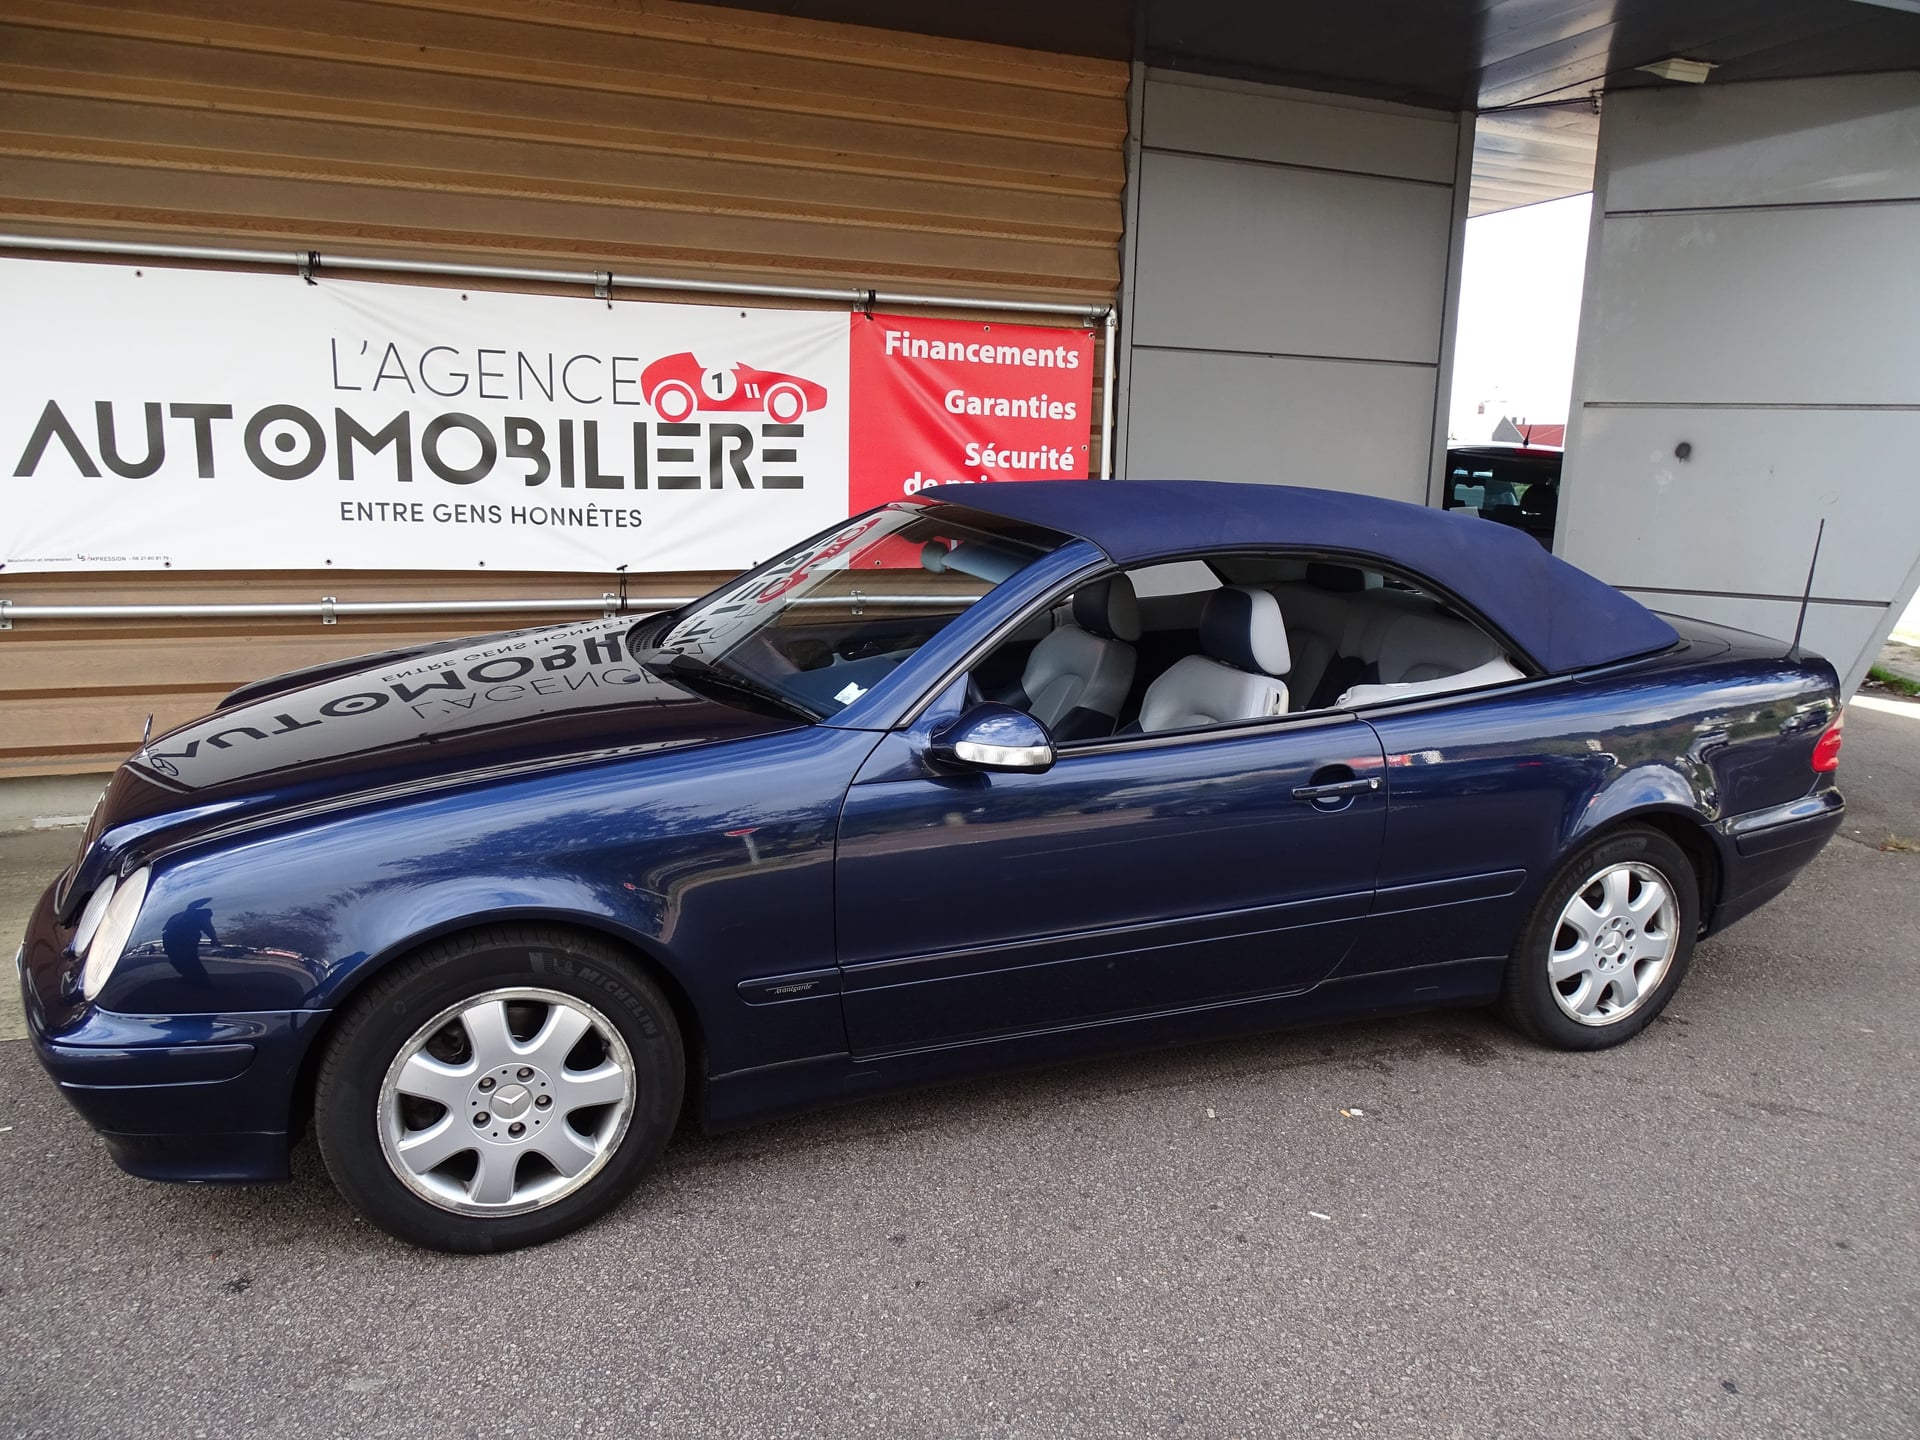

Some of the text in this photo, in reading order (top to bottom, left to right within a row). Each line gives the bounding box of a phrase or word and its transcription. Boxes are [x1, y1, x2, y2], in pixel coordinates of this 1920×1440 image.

[884, 331, 1079, 368] Financements
[331, 337, 641, 405] L'AGENCE
[945, 390, 1077, 419] Garanties
[12, 399, 804, 489] AUTOMOBILIERE
[964, 443, 1074, 471] Sécurité
[341, 501, 642, 528] ENTRE GENS HONNÊTES
[577, 966, 658, 1039] MICHELIN
